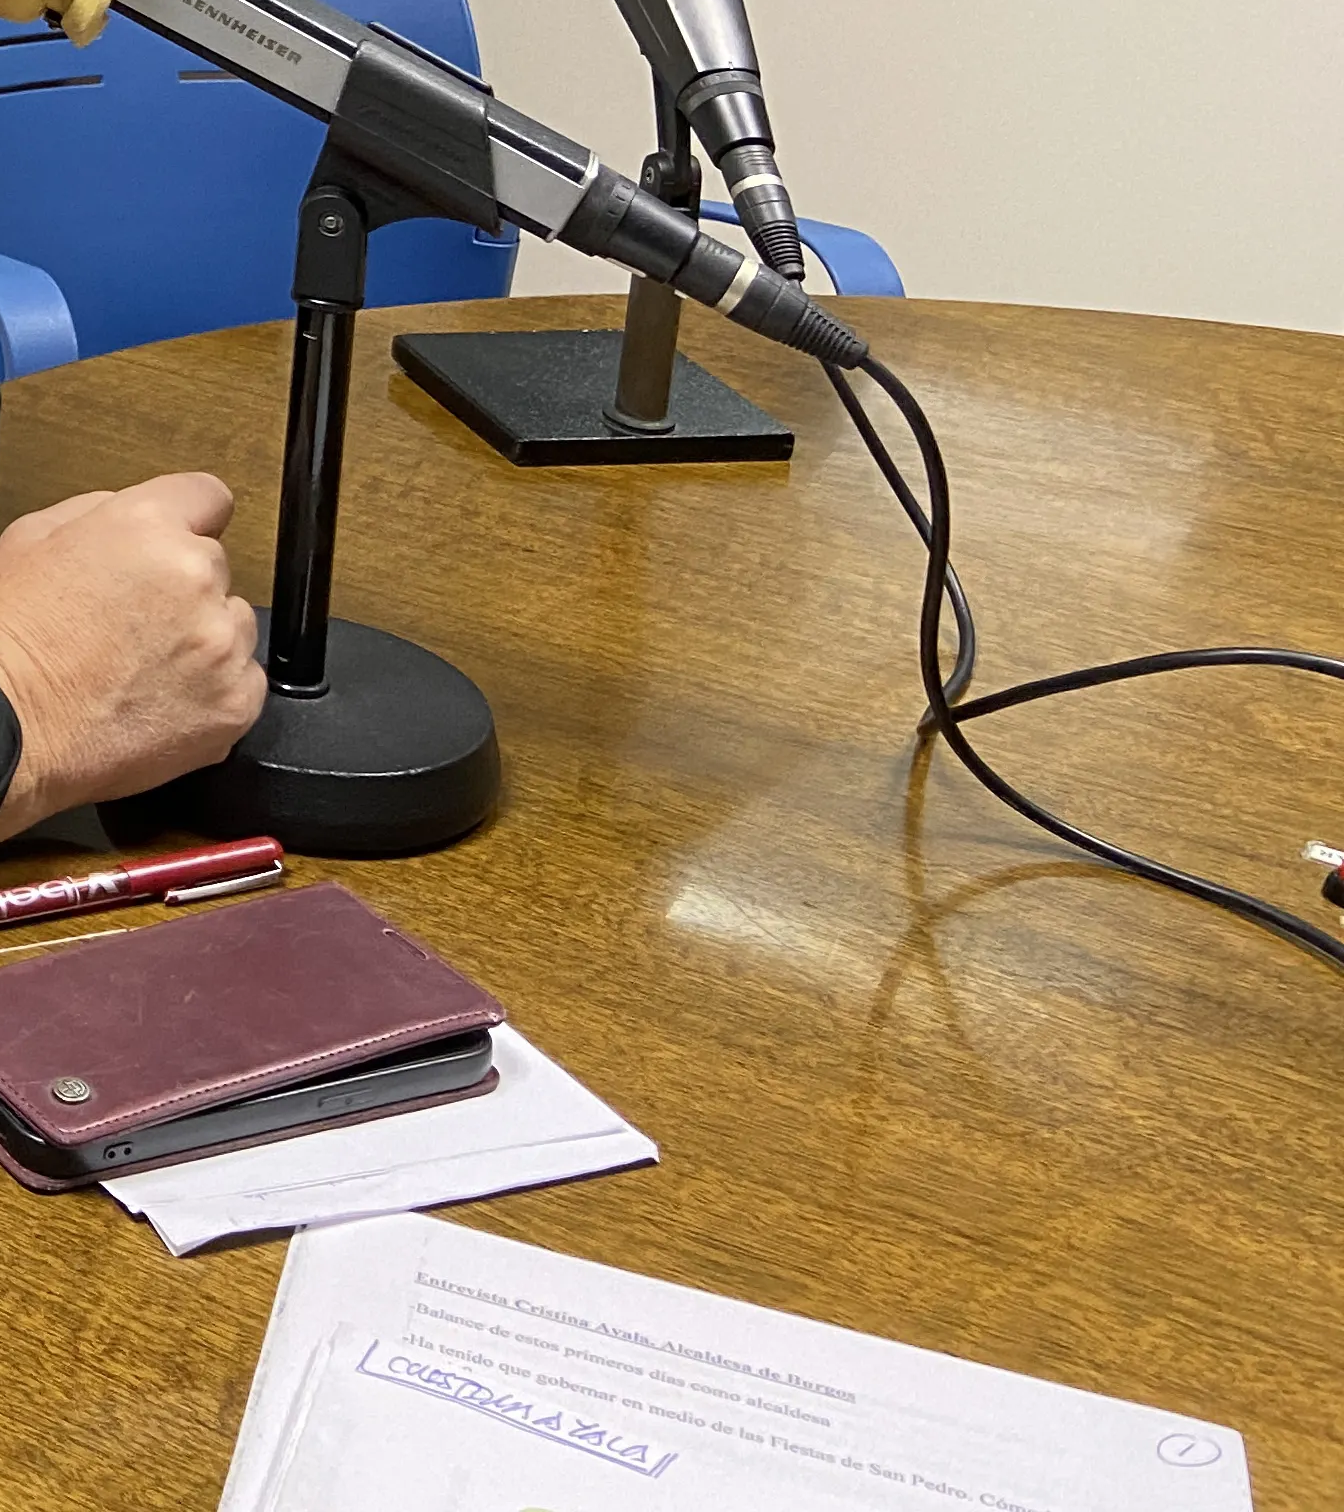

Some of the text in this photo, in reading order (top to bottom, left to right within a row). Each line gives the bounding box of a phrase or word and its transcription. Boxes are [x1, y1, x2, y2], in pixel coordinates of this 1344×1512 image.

[409, 1302, 831, 1427] -Balance de estos primeros días como alcaldesa
[415, 1271, 508, 1307] Entrevista
[515, 1299, 589, 1328] Cristina
[662, 1340, 752, 1374] Alcaldesa
[758, 1367, 781, 1382] de
[787, 1373, 856, 1403] Burgos
[402, 1333, 433, 1350] -Ha
[439, 1342, 494, 1368] tenido
[498, 1361, 531, 1379] que
[535, 1372, 616, 1402] gobernar
[622, 1397, 643, 1410] en
[649, 1403, 706, 1428] medio
[711, 1419, 733, 1434] de
[739, 1426, 765, 1444] las
[770, 1435, 836, 1464] Fiestas
[840, 1454, 863, 1470] de
[868, 1462, 907, 1483] San
[979, 1492, 1040, 1512] Cóm
